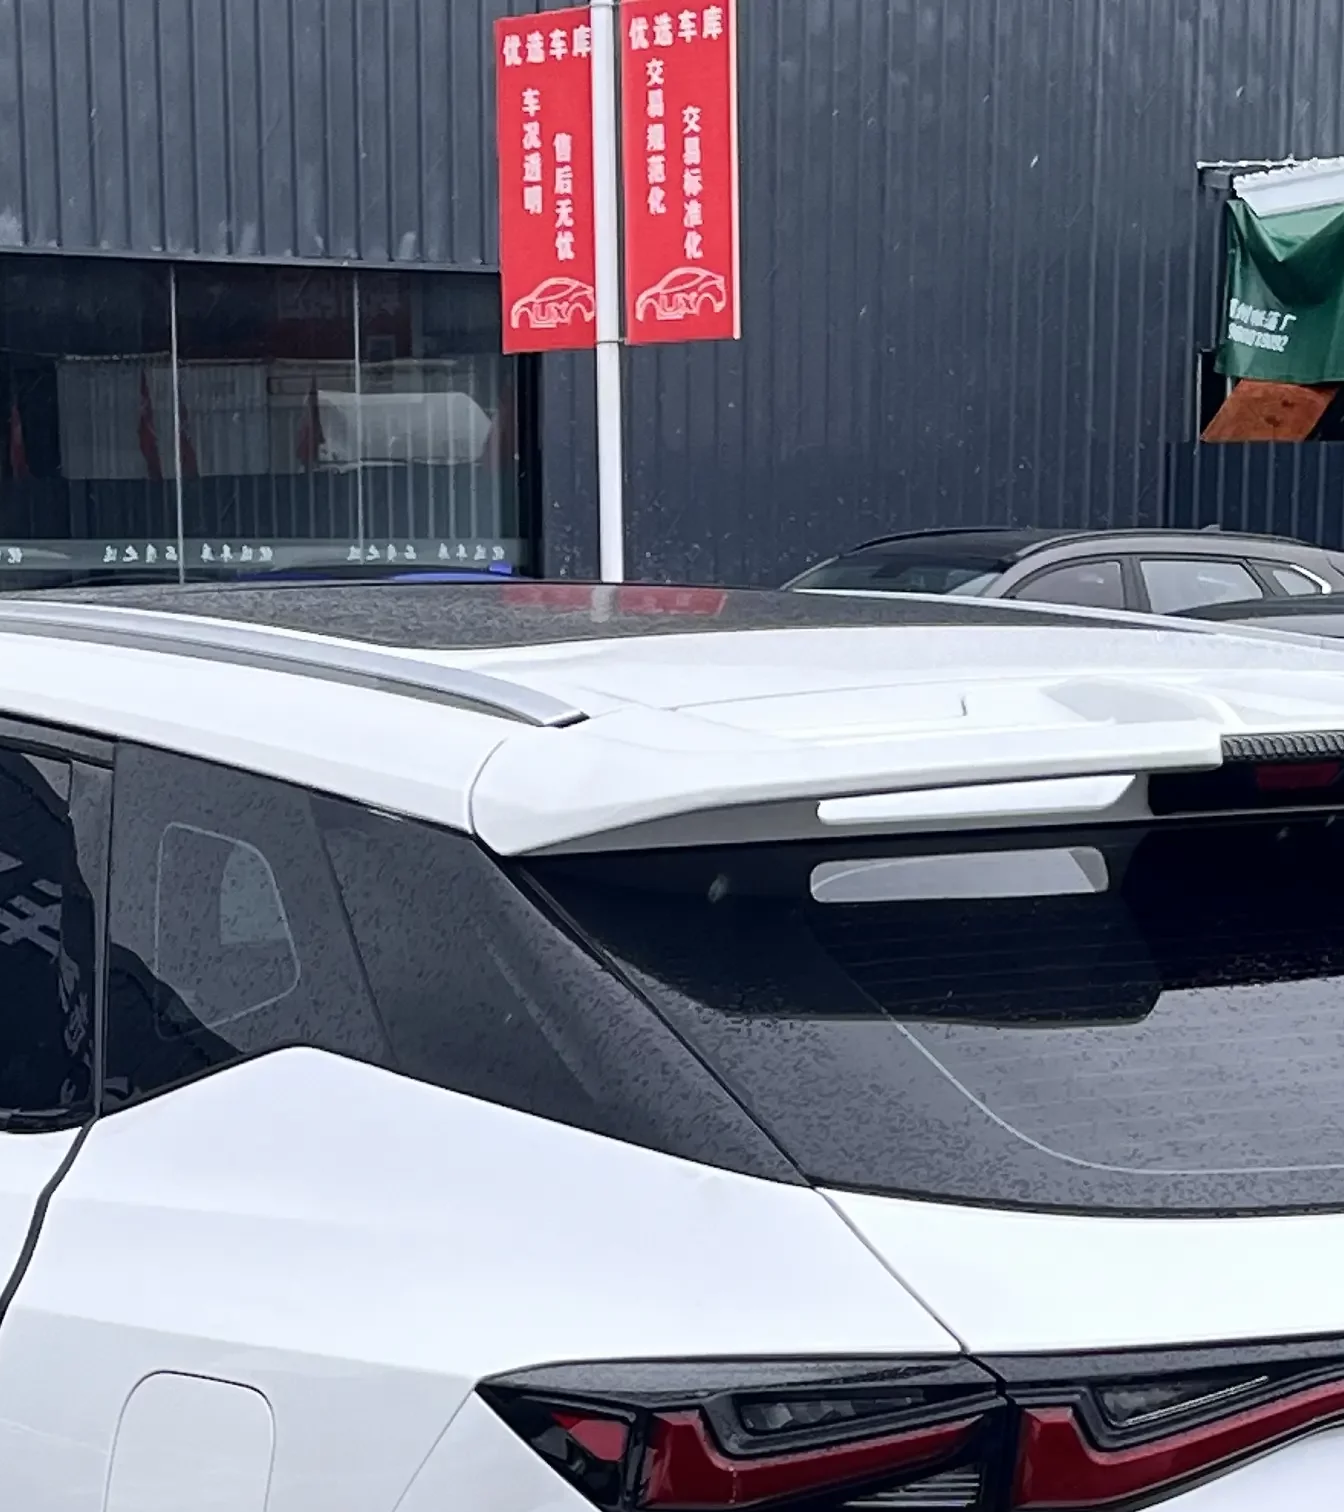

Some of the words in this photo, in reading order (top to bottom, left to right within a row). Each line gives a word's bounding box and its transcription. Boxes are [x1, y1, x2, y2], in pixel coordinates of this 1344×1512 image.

[503, 25, 592, 66] 优选车库
[628, 5, 723, 50] 优选车库
